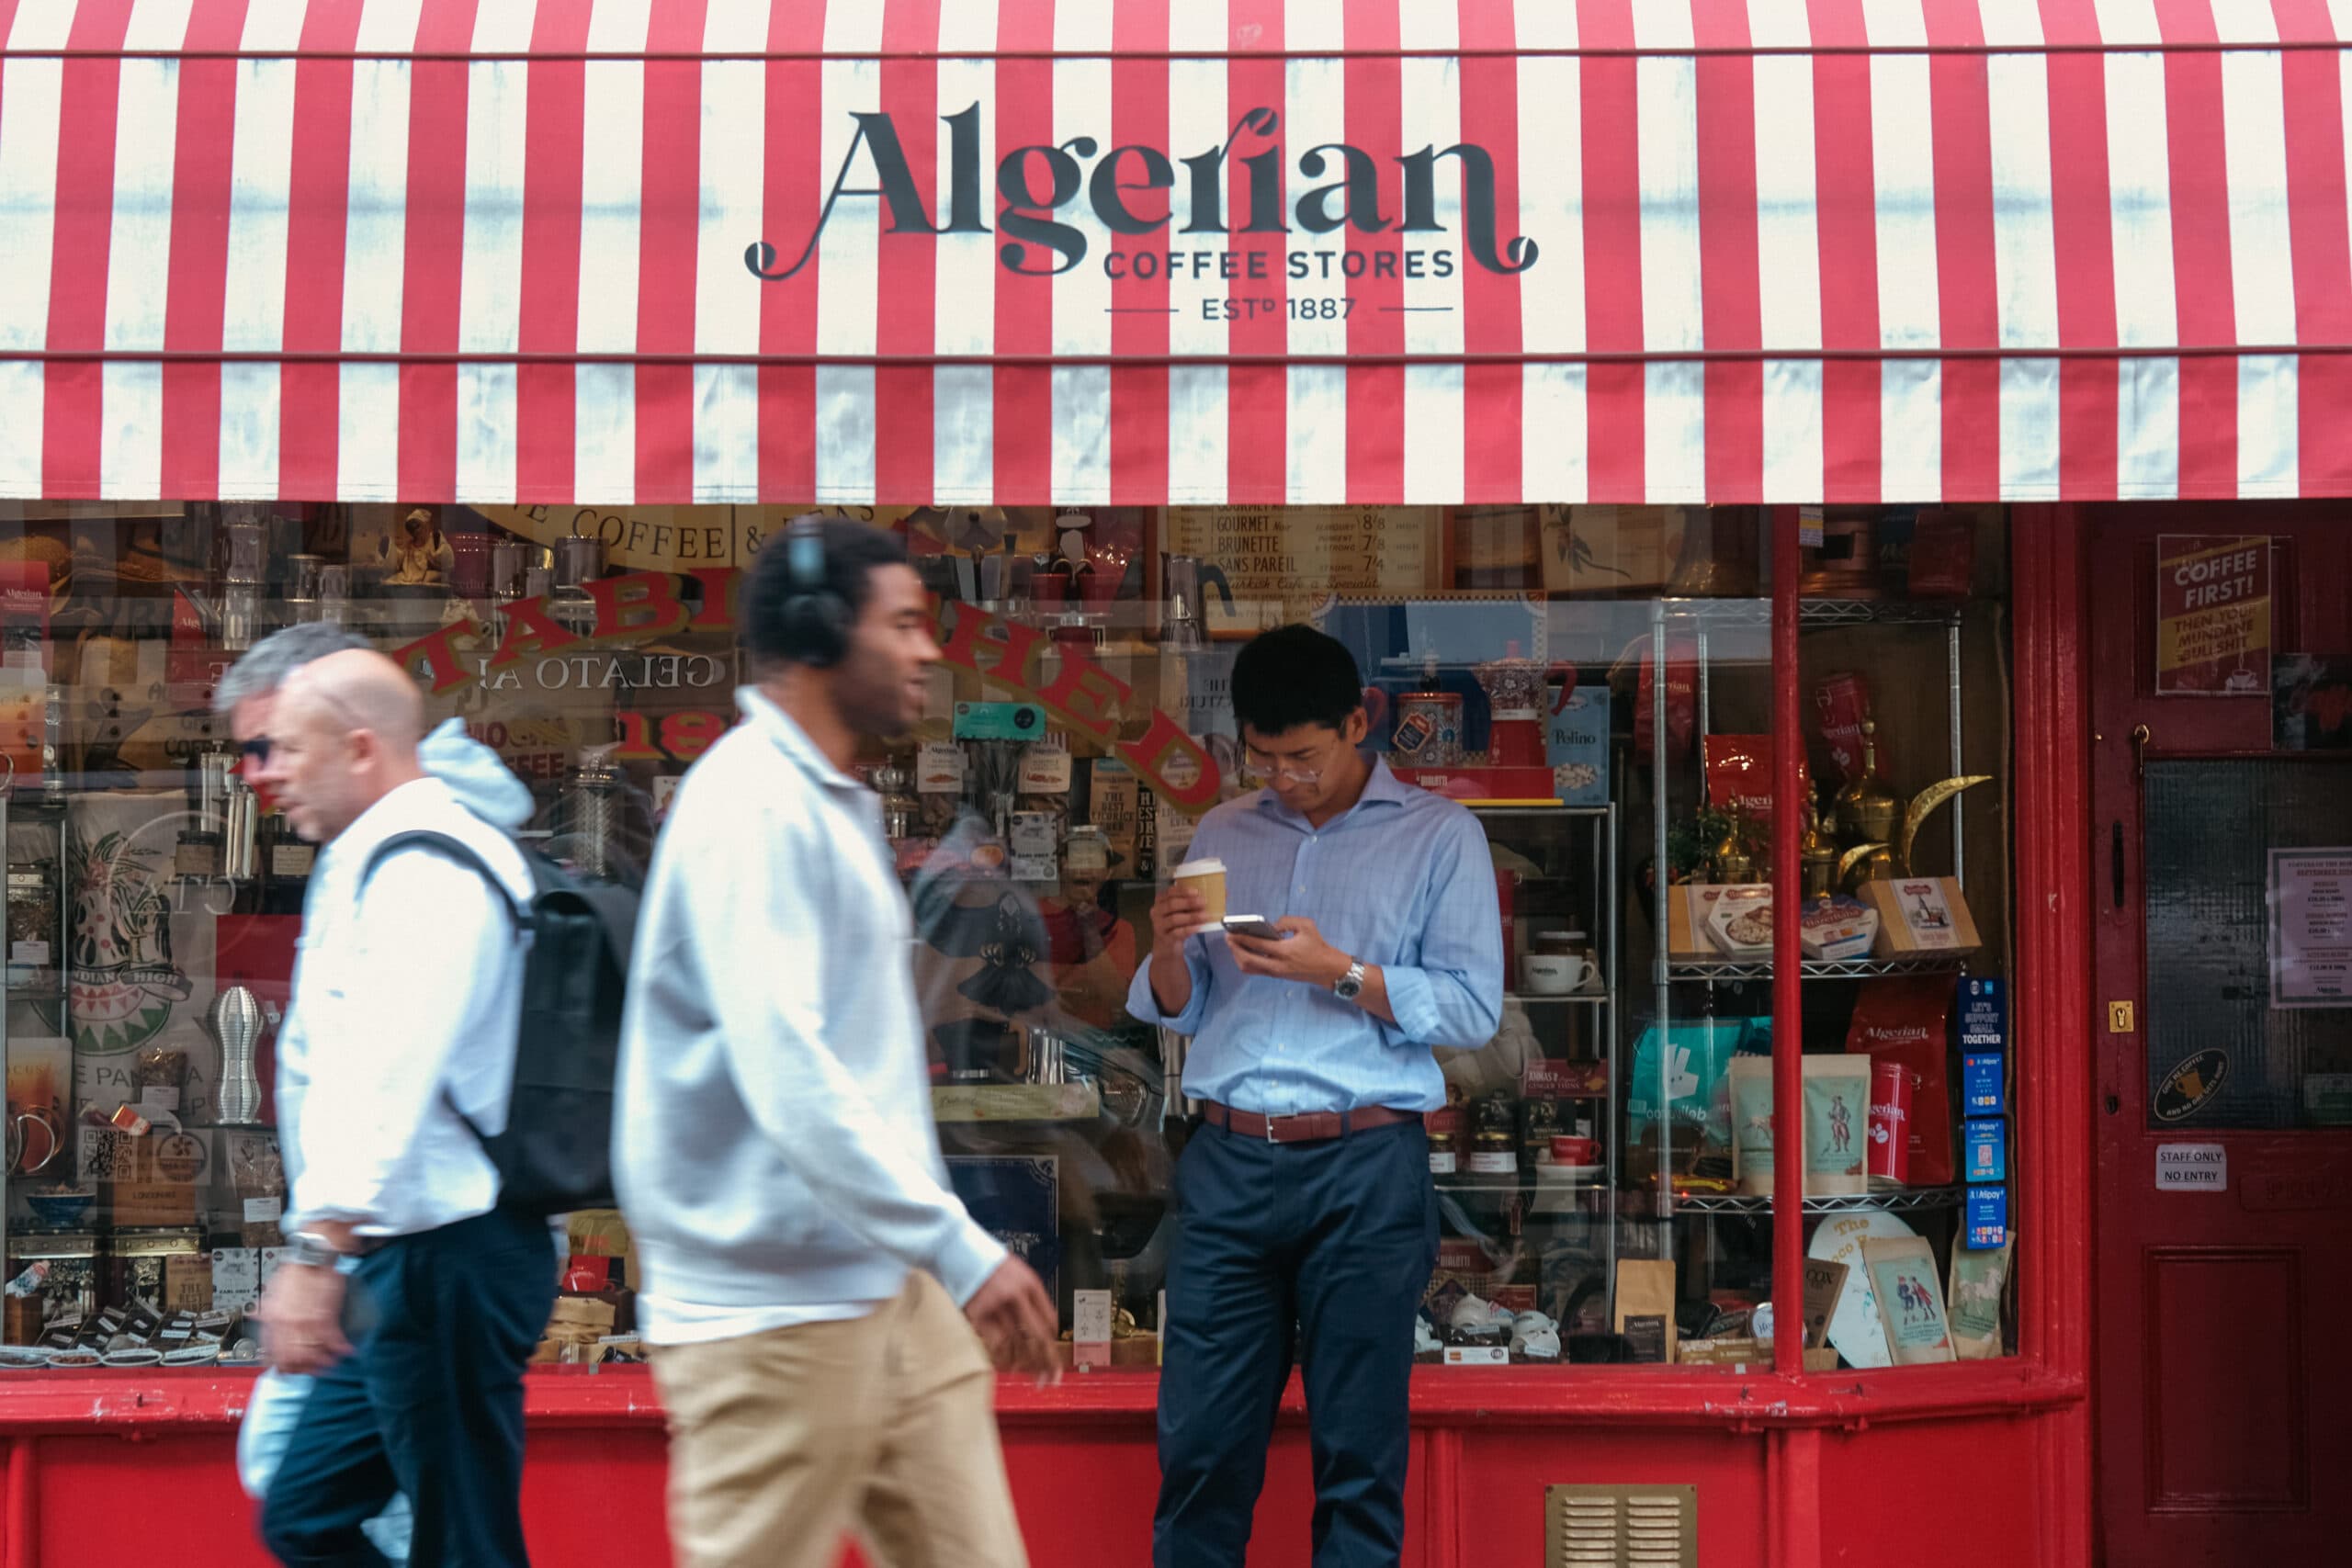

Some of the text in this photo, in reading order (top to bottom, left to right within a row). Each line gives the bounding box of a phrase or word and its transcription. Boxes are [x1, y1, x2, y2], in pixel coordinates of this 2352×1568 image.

[744, 100, 1539, 281] Algerian
[1103, 249, 1455, 280] COFFEE STORES
[1287, 297, 1358, 321] 1887
[1217, 515, 1269, 532] GOURMET
[571, 508, 726, 559] COFFEE
[1218, 536, 1279, 553] BRUNETTE
[1218, 556, 1250, 573] SANS
[1253, 556, 1296, 573] PAREIL
[2175, 550, 2257, 587] COFFEE
[2185, 574, 2255, 610] FIRST!
[2174, 614, 2213, 633] THEN
[2177, 618, 2255, 648] MUNDANE
[133, 972, 179, 987] HIGH
[1962, 1034, 2001, 1044] TOGETHER
[2160, 1151, 2222, 1162] STAFF ONLY
[2164, 1170, 2219, 1181] NO ENTRY
